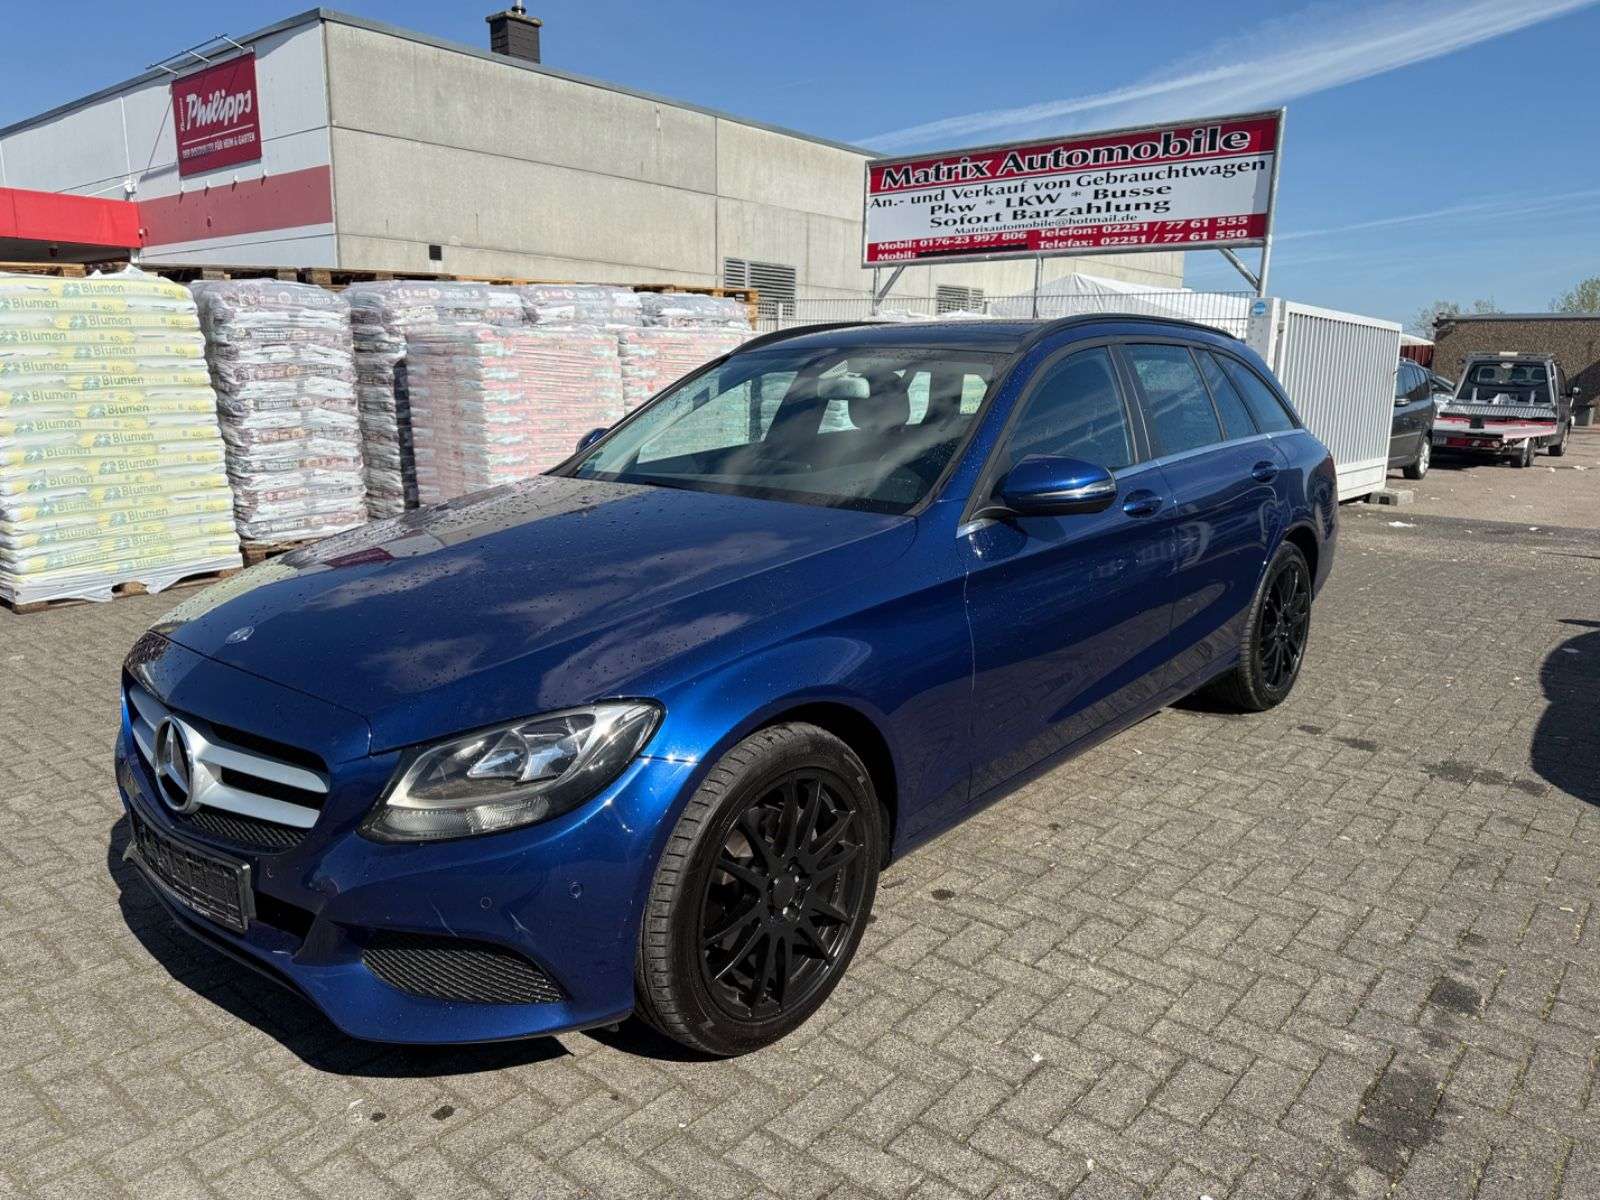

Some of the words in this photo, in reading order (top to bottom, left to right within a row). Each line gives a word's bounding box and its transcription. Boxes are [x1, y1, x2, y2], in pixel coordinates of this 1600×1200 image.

[186, 89, 252, 131] Philipps
[880, 157, 993, 190] Matrix
[996, 125, 1251, 176] Automobile
[910, 189, 946, 205] und
[951, 180, 1028, 200] Verkauf
[1032, 179, 1071, 191] von
[1076, 160, 1266, 187] Gebrauchtwagen
[930, 203, 977, 216] Pkw
[1005, 192, 1062, 208] LKW
[1093, 185, 1172, 200] Busse
[929, 212, 1003, 229] Sofort
[1012, 200, 1171, 221] Barzahlung
[1039, 227, 1098, 238] Telefon:
[1101, 222, 1150, 234] 02251
[1165, 220, 1187, 230] 77
[1190, 219, 1209, 228] 61
[1216, 215, 1248, 227] 555
[878, 241, 917, 251] Mobil:
[919, 235, 970, 248] 0176-23
[972, 233, 999, 244] 997
[1001, 231, 1028, 240] 806
[1038, 237, 1095, 249] Telefax:
[1099, 234, 1147, 246] 02251
[1163, 232, 1185, 242] 77
[1189, 231, 1208, 240] 61
[1215, 228, 1248, 239] 550
[877, 251, 917, 261] Mobil:
[82, 283, 124, 293] Blumen
[11, 298, 59, 308] Blumen
[89, 315, 132, 326] Blumen
[20, 330, 67, 341] Blumen
[92, 344, 136, 355] Blumen
[22, 361, 69, 371] Blumen
[102, 375, 144, 385] Blumen
[32, 390, 78, 401] Blumen
[107, 404, 150, 414] Blumen
[35, 419, 81, 430] Blumen
[112, 433, 154, 443] Blumen
[118, 458, 160, 470] Blumen
[128, 508, 169, 521] Blumen
